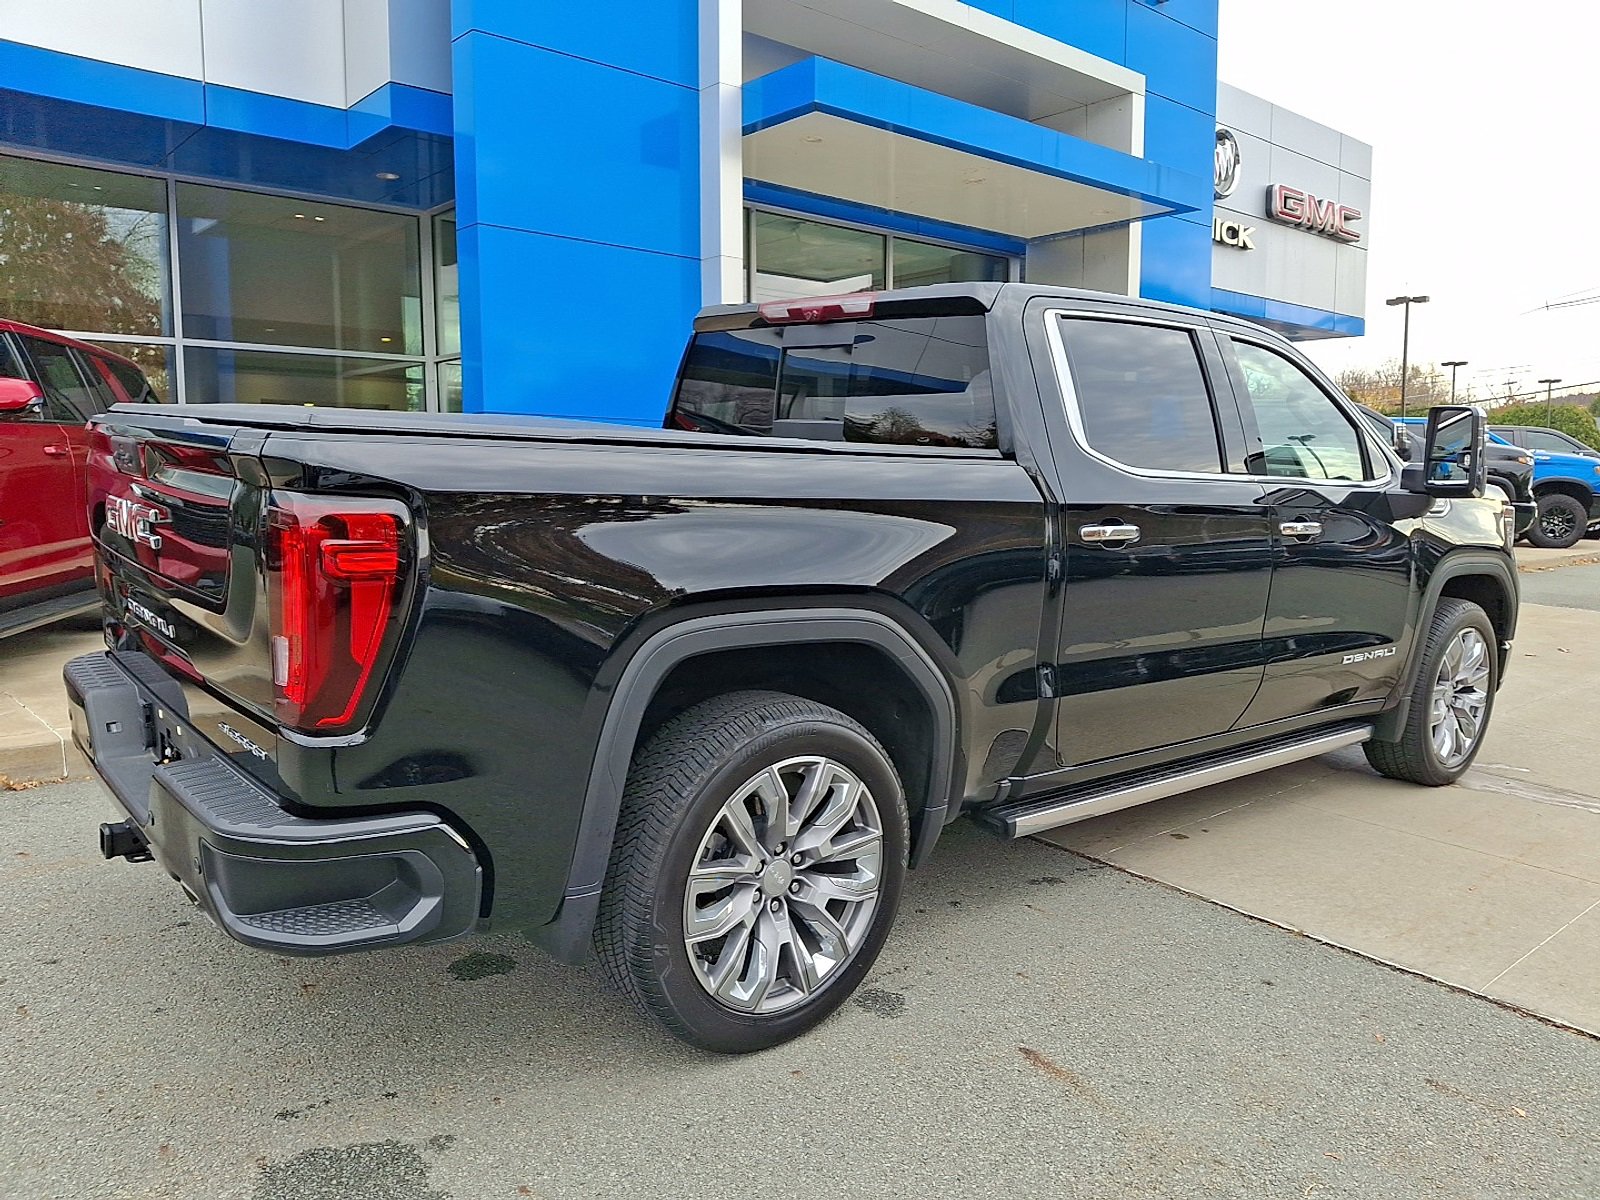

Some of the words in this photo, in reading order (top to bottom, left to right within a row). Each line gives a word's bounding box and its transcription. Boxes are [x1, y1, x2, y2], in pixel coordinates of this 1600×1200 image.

[1212, 217, 1256, 249] ICK
[1270, 184, 1362, 239] GMC
[105, 494, 162, 550] GMC
[1342, 647, 1396, 664] DENALI
